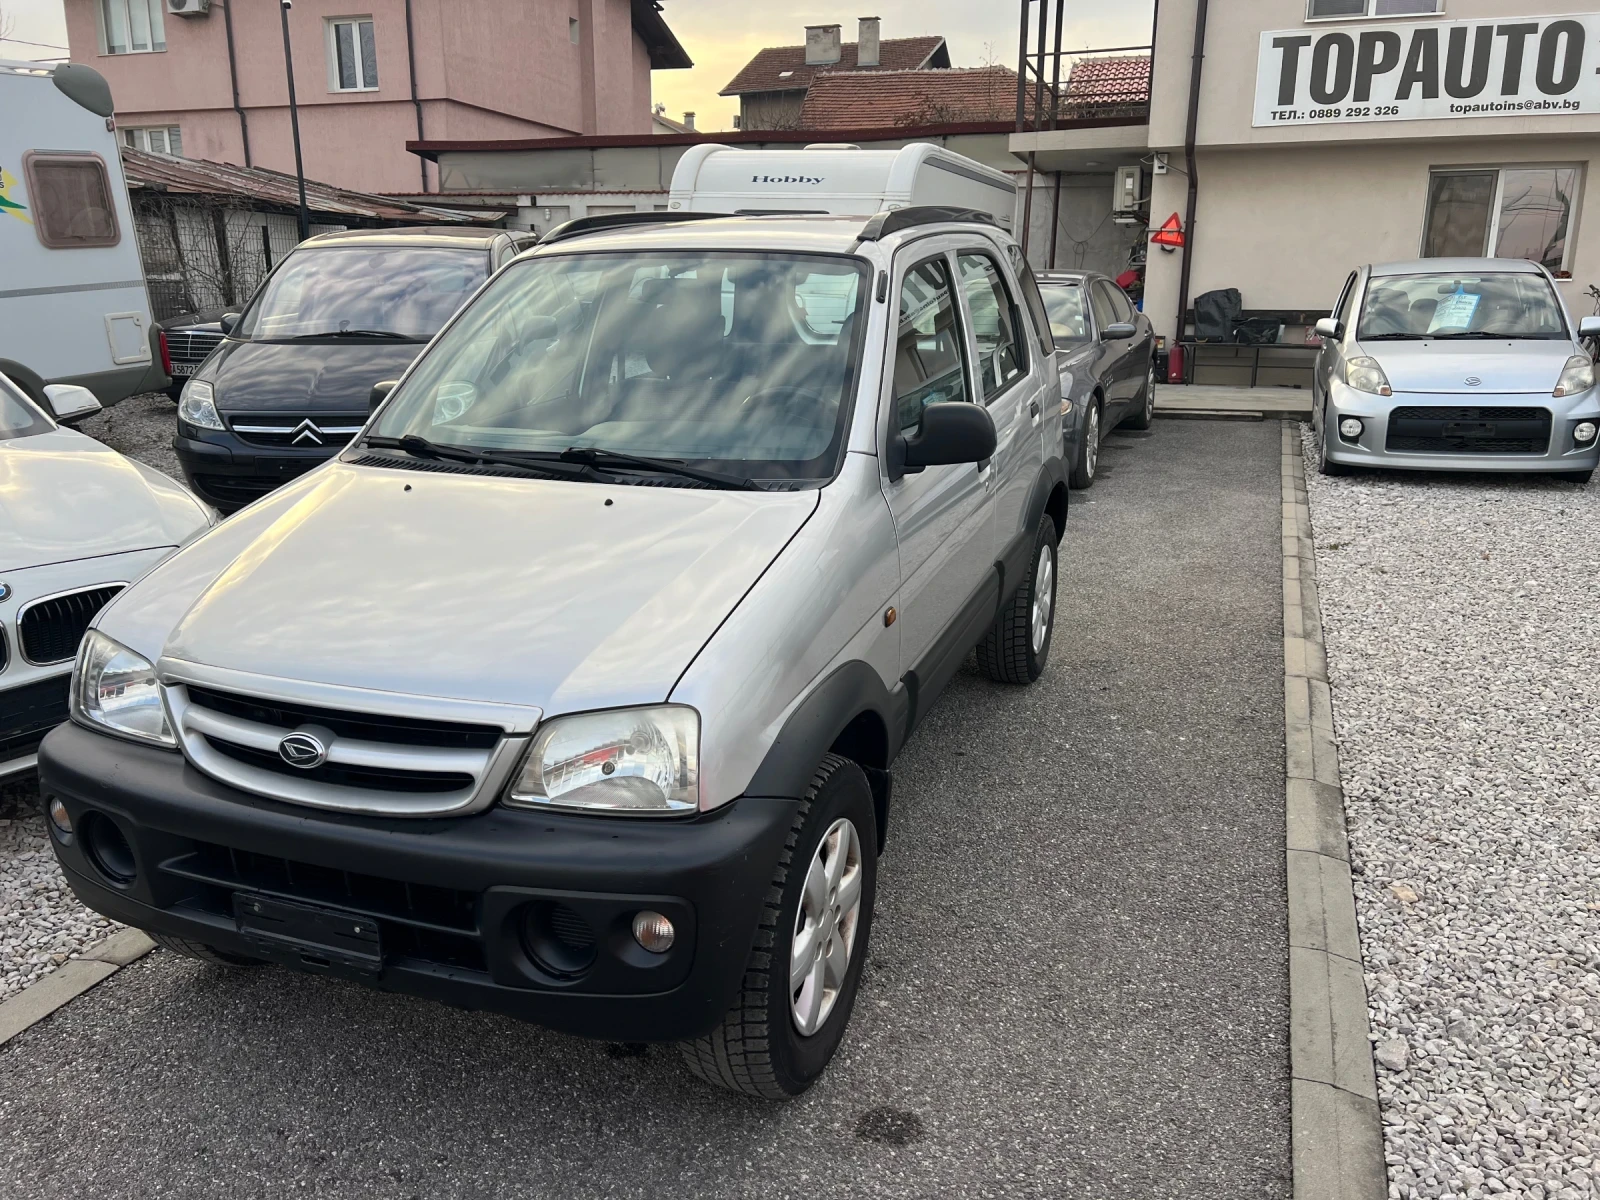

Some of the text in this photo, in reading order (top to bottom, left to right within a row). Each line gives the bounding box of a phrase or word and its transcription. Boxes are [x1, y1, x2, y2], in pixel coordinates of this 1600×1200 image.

[1272, 19, 1586, 106] TOPAUTO
[1270, 105, 1400, 120] ТЕЛ.: 0889 292 326
[1449, 99, 1580, 114] topautoins@abv.bg
[751, 175, 826, 185] Hobby
